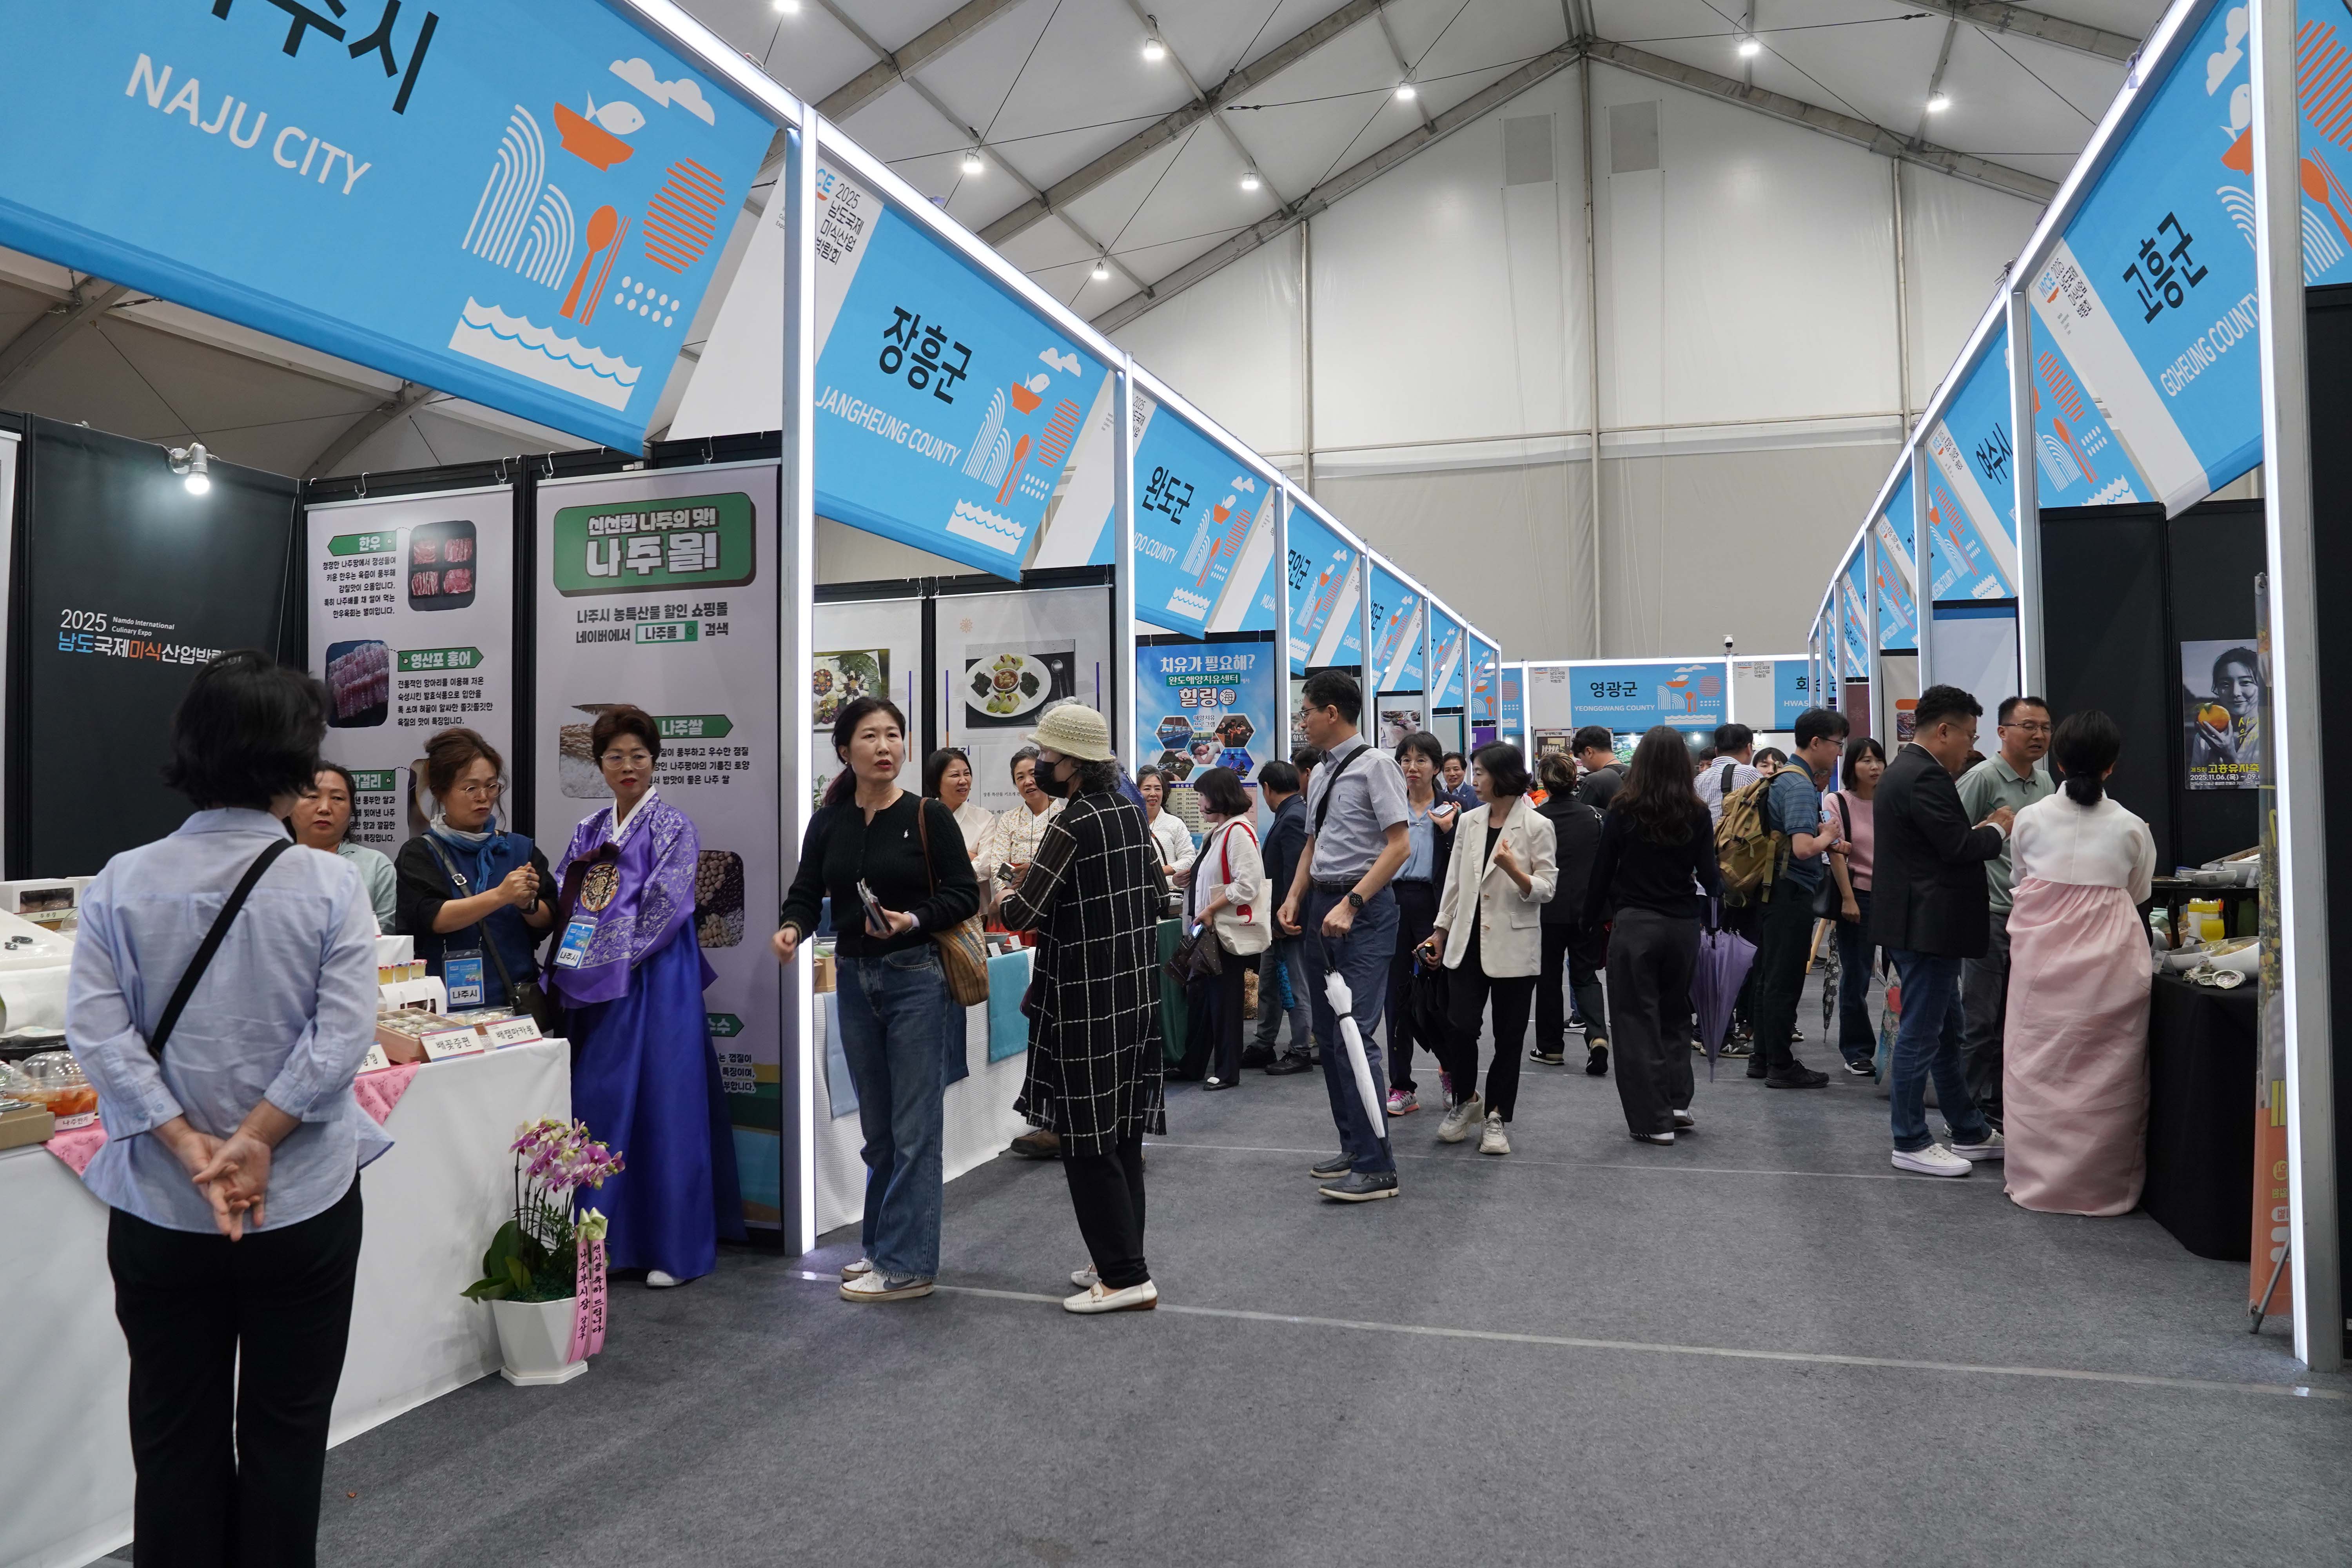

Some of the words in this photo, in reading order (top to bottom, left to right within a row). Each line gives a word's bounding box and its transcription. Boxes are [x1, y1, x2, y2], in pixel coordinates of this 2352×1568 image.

[125, 53, 267, 149] NAJU
[273, 126, 372, 195] CITY
[835, 183, 860, 209] 2025
[828, 200, 864, 235] 남도국제
[820, 219, 857, 252] 미식산업
[817, 236, 841, 265] 박람회
[2122, 211, 2208, 324] 고흥군
[880, 305, 972, 404] 장흥군
[2160, 337, 2216, 396] GOHEUNG
[1133, 396, 1145, 410] 2025
[816, 386, 907, 444] JANGHEUNG
[909, 428, 962, 466] COUNTY
[1976, 423, 2013, 485] 여수시
[1142, 466, 1194, 524] 완도군
[589, 515, 637, 535] 신선한
[639, 510, 689, 531] 나주의
[692, 508, 716, 526] 맛!
[359, 536, 380, 551] 한우
[1145, 539, 1178, 564] COUNTY
[323, 561, 339, 570] 청정한
[342, 558, 370, 568] 나주땅에서
[339, 572, 356, 581] 한우는
[358, 570, 375, 579] 육즙이
[339, 584, 361, 593] 감칠맛이
[364, 582, 395, 591] 으뜸입니다.
[324, 598, 334, 606] 특히
[383, 594, 395, 603] 먹는
[333, 609, 361, 619] 한우육회는
[363, 606, 395, 616] 별미입니다.
[577, 609, 610, 623] 나주시
[614, 606, 660, 621] 농특산물
[664, 604, 687, 619] 할인
[691, 602, 728, 617] 쇼핑몰
[60, 609, 107, 632] 2025
[113, 617, 134, 625] Namdo
[135, 620, 175, 630] International
[112, 626, 137, 635] Culinary
[576, 629, 630, 643] 네이버에서
[645, 626, 677, 640] 나주몰
[705, 623, 729, 636] 검색
[58, 631, 226, 665] 남도국제미식산업박
[411, 653, 444, 668] 영산포
[447, 651, 470, 666] 홍어
[1160, 656, 1202, 673] 치유가
[1205, 654, 1256, 671] 필요해?
[398, 680, 421, 689] 전통적인
[424, 679, 448, 688] 항아리를
[450, 677, 468, 686] 이용해
[471, 677, 484, 685] 저온
[1168, 675, 1238, 686] 완도해양치유센터
[398, 692, 421, 701] 숙성시킨
[424, 691, 459, 700] 발효식품으로
[462, 690, 481, 699] 입안을
[1590, 681, 1638, 698] 영광군
[1179, 687, 1218, 708] 힐링
[420, 704, 437, 713] 혀끝이
[439, 704, 458, 712] 알싸한
[461, 702, 493, 712] 쫄깃쫄깃한
[397, 718, 416, 727] 육질의
[418, 717, 429, 726] 맛이
[432, 716, 464, 726] 특징입니다.
[661, 719, 703, 735] 나주쌀
[677, 748, 705, 757] 풍부하고
[708, 747, 731, 756] 우수한
[670, 762, 706, 771] 나주평야의
[710, 761, 731, 770] 기름진
[734, 761, 750, 770] 토양
[663, 776, 684, 784] 밥맛이
[687, 775, 702, 784] 좋은
[704, 775, 719, 784] 나주
[722, 775, 730, 784] 쌀
[363, 796, 380, 804] 풍부한
[383, 796, 396, 804] 쌀과
[383, 809, 396, 817] 나주
[363, 821, 375, 829] 향과
[377, 821, 395, 830] 깔끔한
[364, 834, 395, 842] 특징입니다.
[560, 951, 579, 962] 나주시
[453, 989, 477, 999] 나주시
[729, 1053, 751, 1063] 껍질이
[722, 1067, 755, 1078] 특징이며,
[593, 1244, 603, 1272] 전시를
[578, 1249, 590, 1310] 나주부시장
